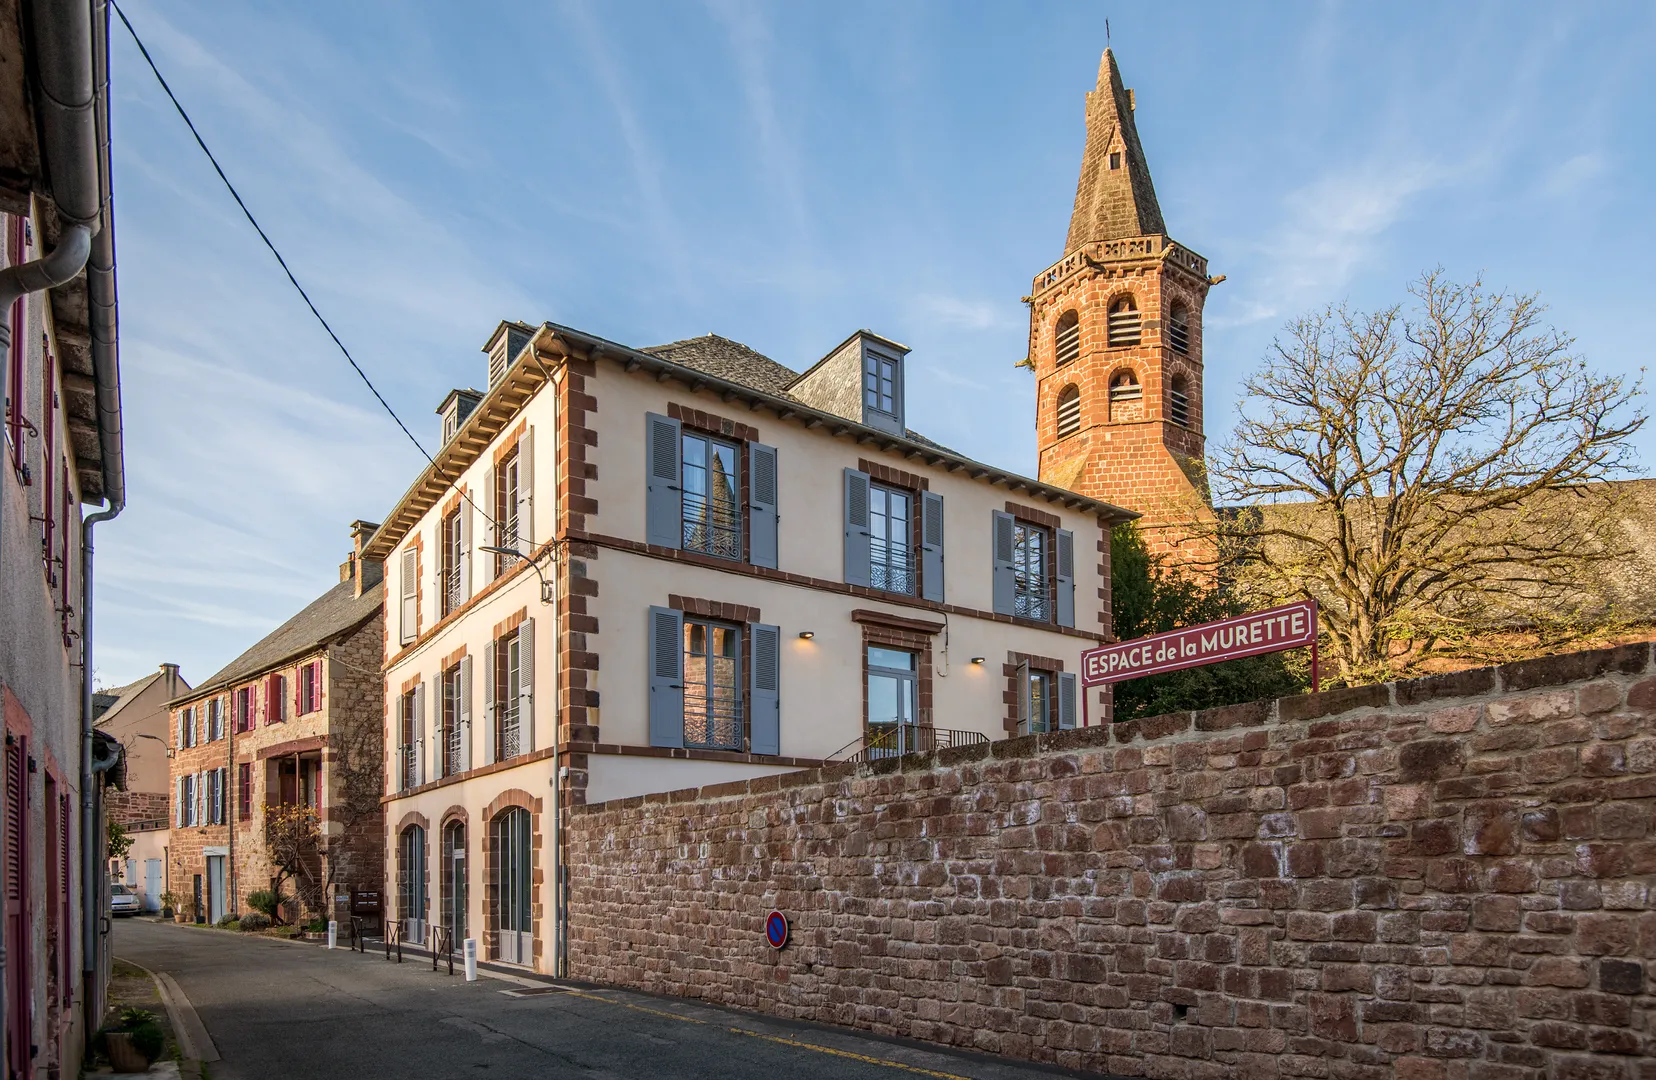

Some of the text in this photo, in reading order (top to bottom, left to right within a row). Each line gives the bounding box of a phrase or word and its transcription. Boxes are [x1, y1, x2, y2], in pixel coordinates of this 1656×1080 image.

[1089, 612, 1304, 676] ESPACE de la MURETTE
